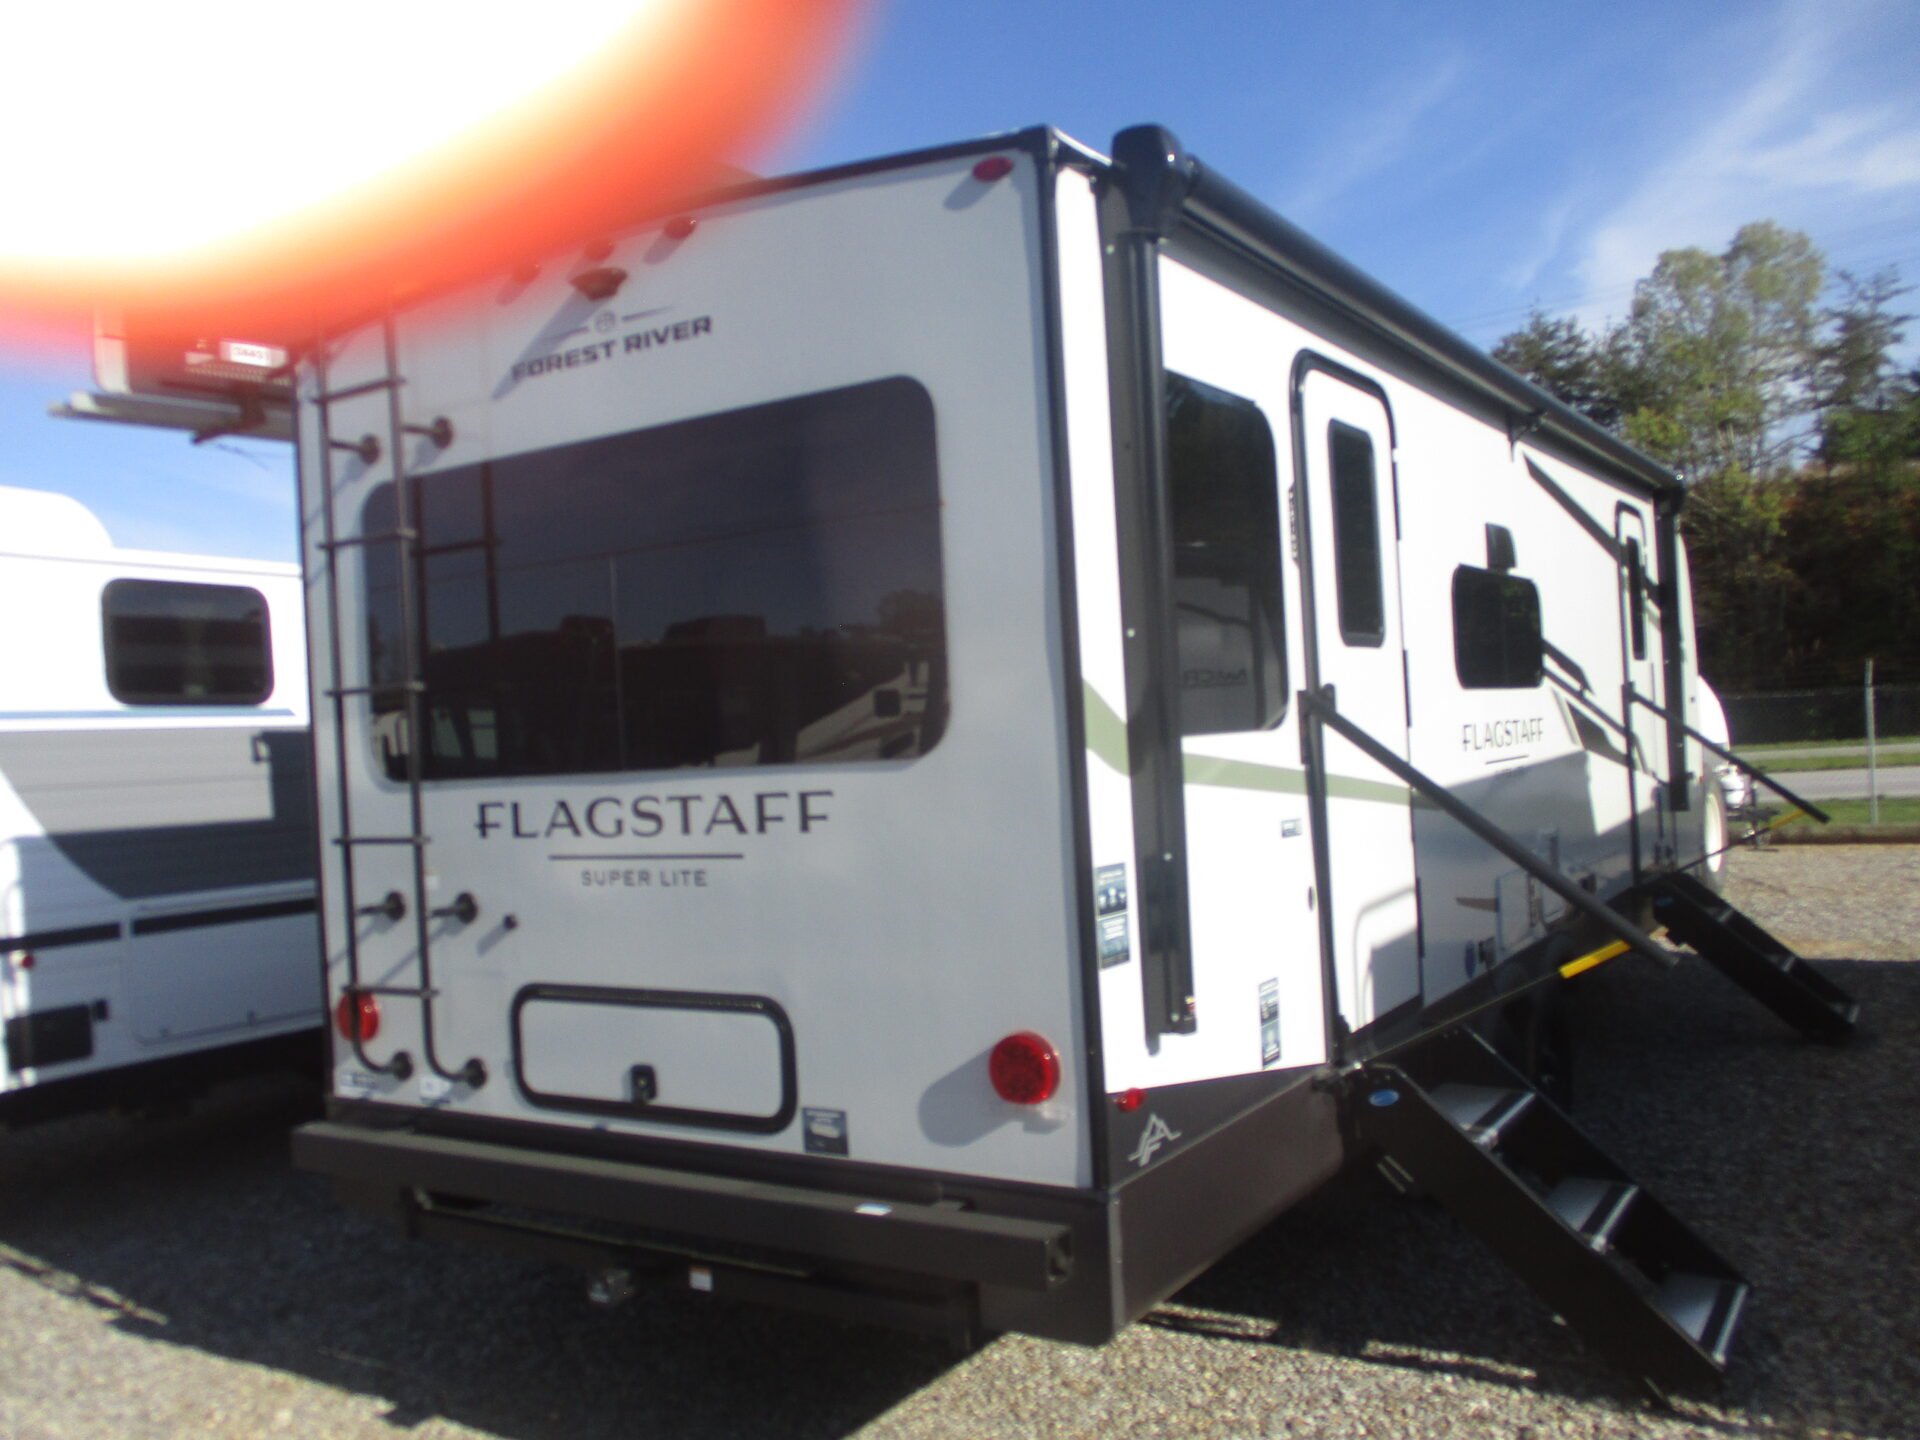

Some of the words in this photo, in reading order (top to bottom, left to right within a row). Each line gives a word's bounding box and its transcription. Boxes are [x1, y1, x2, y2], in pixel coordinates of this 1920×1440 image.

[512, 340, 616, 381] FOREST
[622, 315, 713, 352] RIVER
[1463, 718, 1543, 751] FLAGSTAFF
[475, 790, 834, 839] FLAGSTAFF
[580, 870, 651, 888] SUPER
[659, 869, 708, 887] LITE
